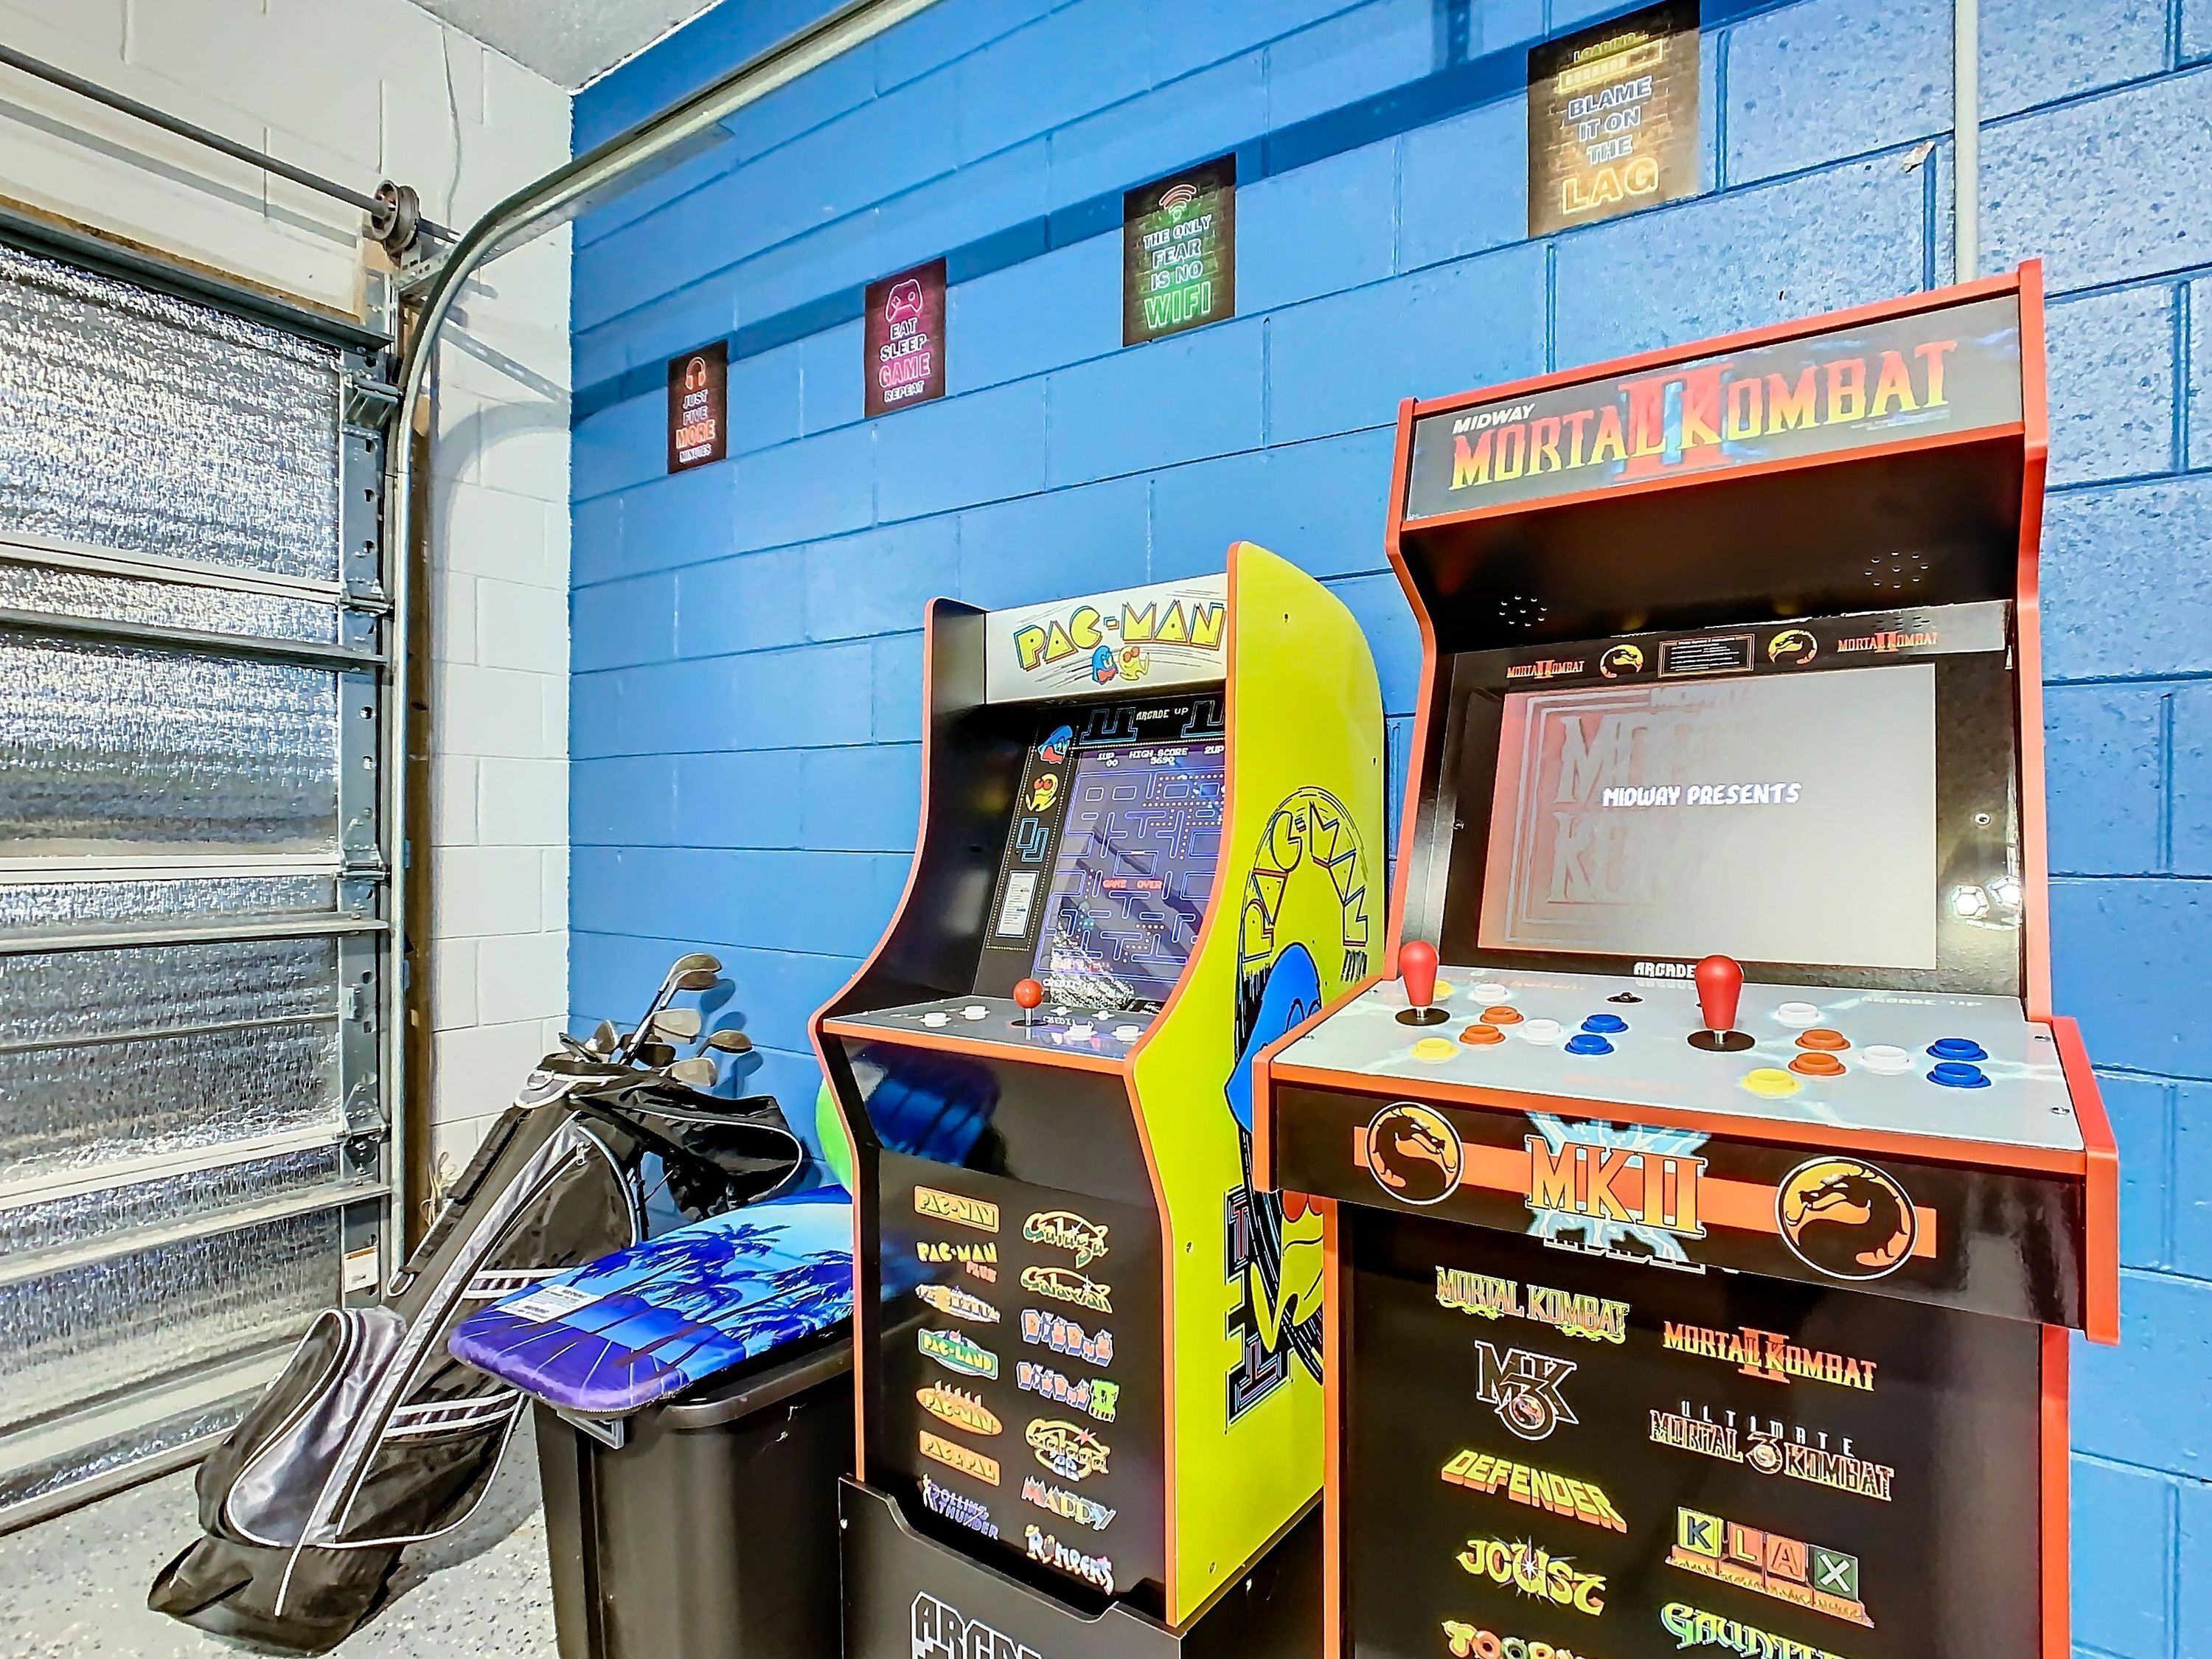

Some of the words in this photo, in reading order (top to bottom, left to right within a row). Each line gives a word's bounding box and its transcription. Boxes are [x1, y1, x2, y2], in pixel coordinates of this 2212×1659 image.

[1568, 76, 1652, 119] BLAME
[1579, 119, 1601, 142] IT
[1604, 106, 1640, 131] ON
[1587, 134, 1633, 165] THE
[1562, 157, 1658, 215] LAG
[1144, 229, 1172, 249] THE
[1173, 215, 1211, 239] ONLY
[1152, 238, 1202, 269] FEAR
[1150, 270, 1170, 291] IS
[1175, 260, 1203, 284] NO
[1144, 281, 1211, 329] WIFI
[890, 317, 917, 340] EAT
[880, 334, 927, 361] SLEEP
[879, 352, 931, 388] GAME
[683, 389, 708, 409] JUST
[884, 380, 925, 402] REPEAT
[683, 406, 708, 425] FIVE
[1448, 397, 1668, 490] MORTAL
[1676, 340, 1957, 449] KOMBAT
[1452, 403, 1536, 434] MIDWAY
[675, 420, 715, 449] MORE
[1013, 599, 1226, 672] PAC-MAN
[1136, 709, 1169, 720] ARCADE
[1602, 785, 1682, 807] MIDWAY
[1686, 782, 1802, 807] PRESENTS
[1103, 879, 1127, 888] GAME
[1137, 880, 1163, 889] OVER
[1633, 961, 1696, 978] ARCADE
[917, 1242, 998, 1263] PAC-MAN
[966, 1260, 997, 1283] PLUS
[1436, 1265, 1524, 1320] MORTAL
[1526, 1284, 1630, 1343] KOMBAT
[923, 1335, 993, 1371] PAC-LAND
[1663, 1321, 1762, 1368] MORTAL
[1764, 1340, 1877, 1392] KOMBAT
[1680, 1400, 1855, 1458] ULTIMATE
[1649, 1409, 1744, 1464] MORTAL
[1784, 1441, 1895, 1501] KOMBAT
[929, 1482, 990, 1520] ROLLING
[1021, 1475, 1117, 1531] MAPPY
[1441, 1449, 1627, 1534] DEFENDER
[938, 1500, 999, 1540] THUNDER
[1686, 1514, 1851, 1593] KLAX
